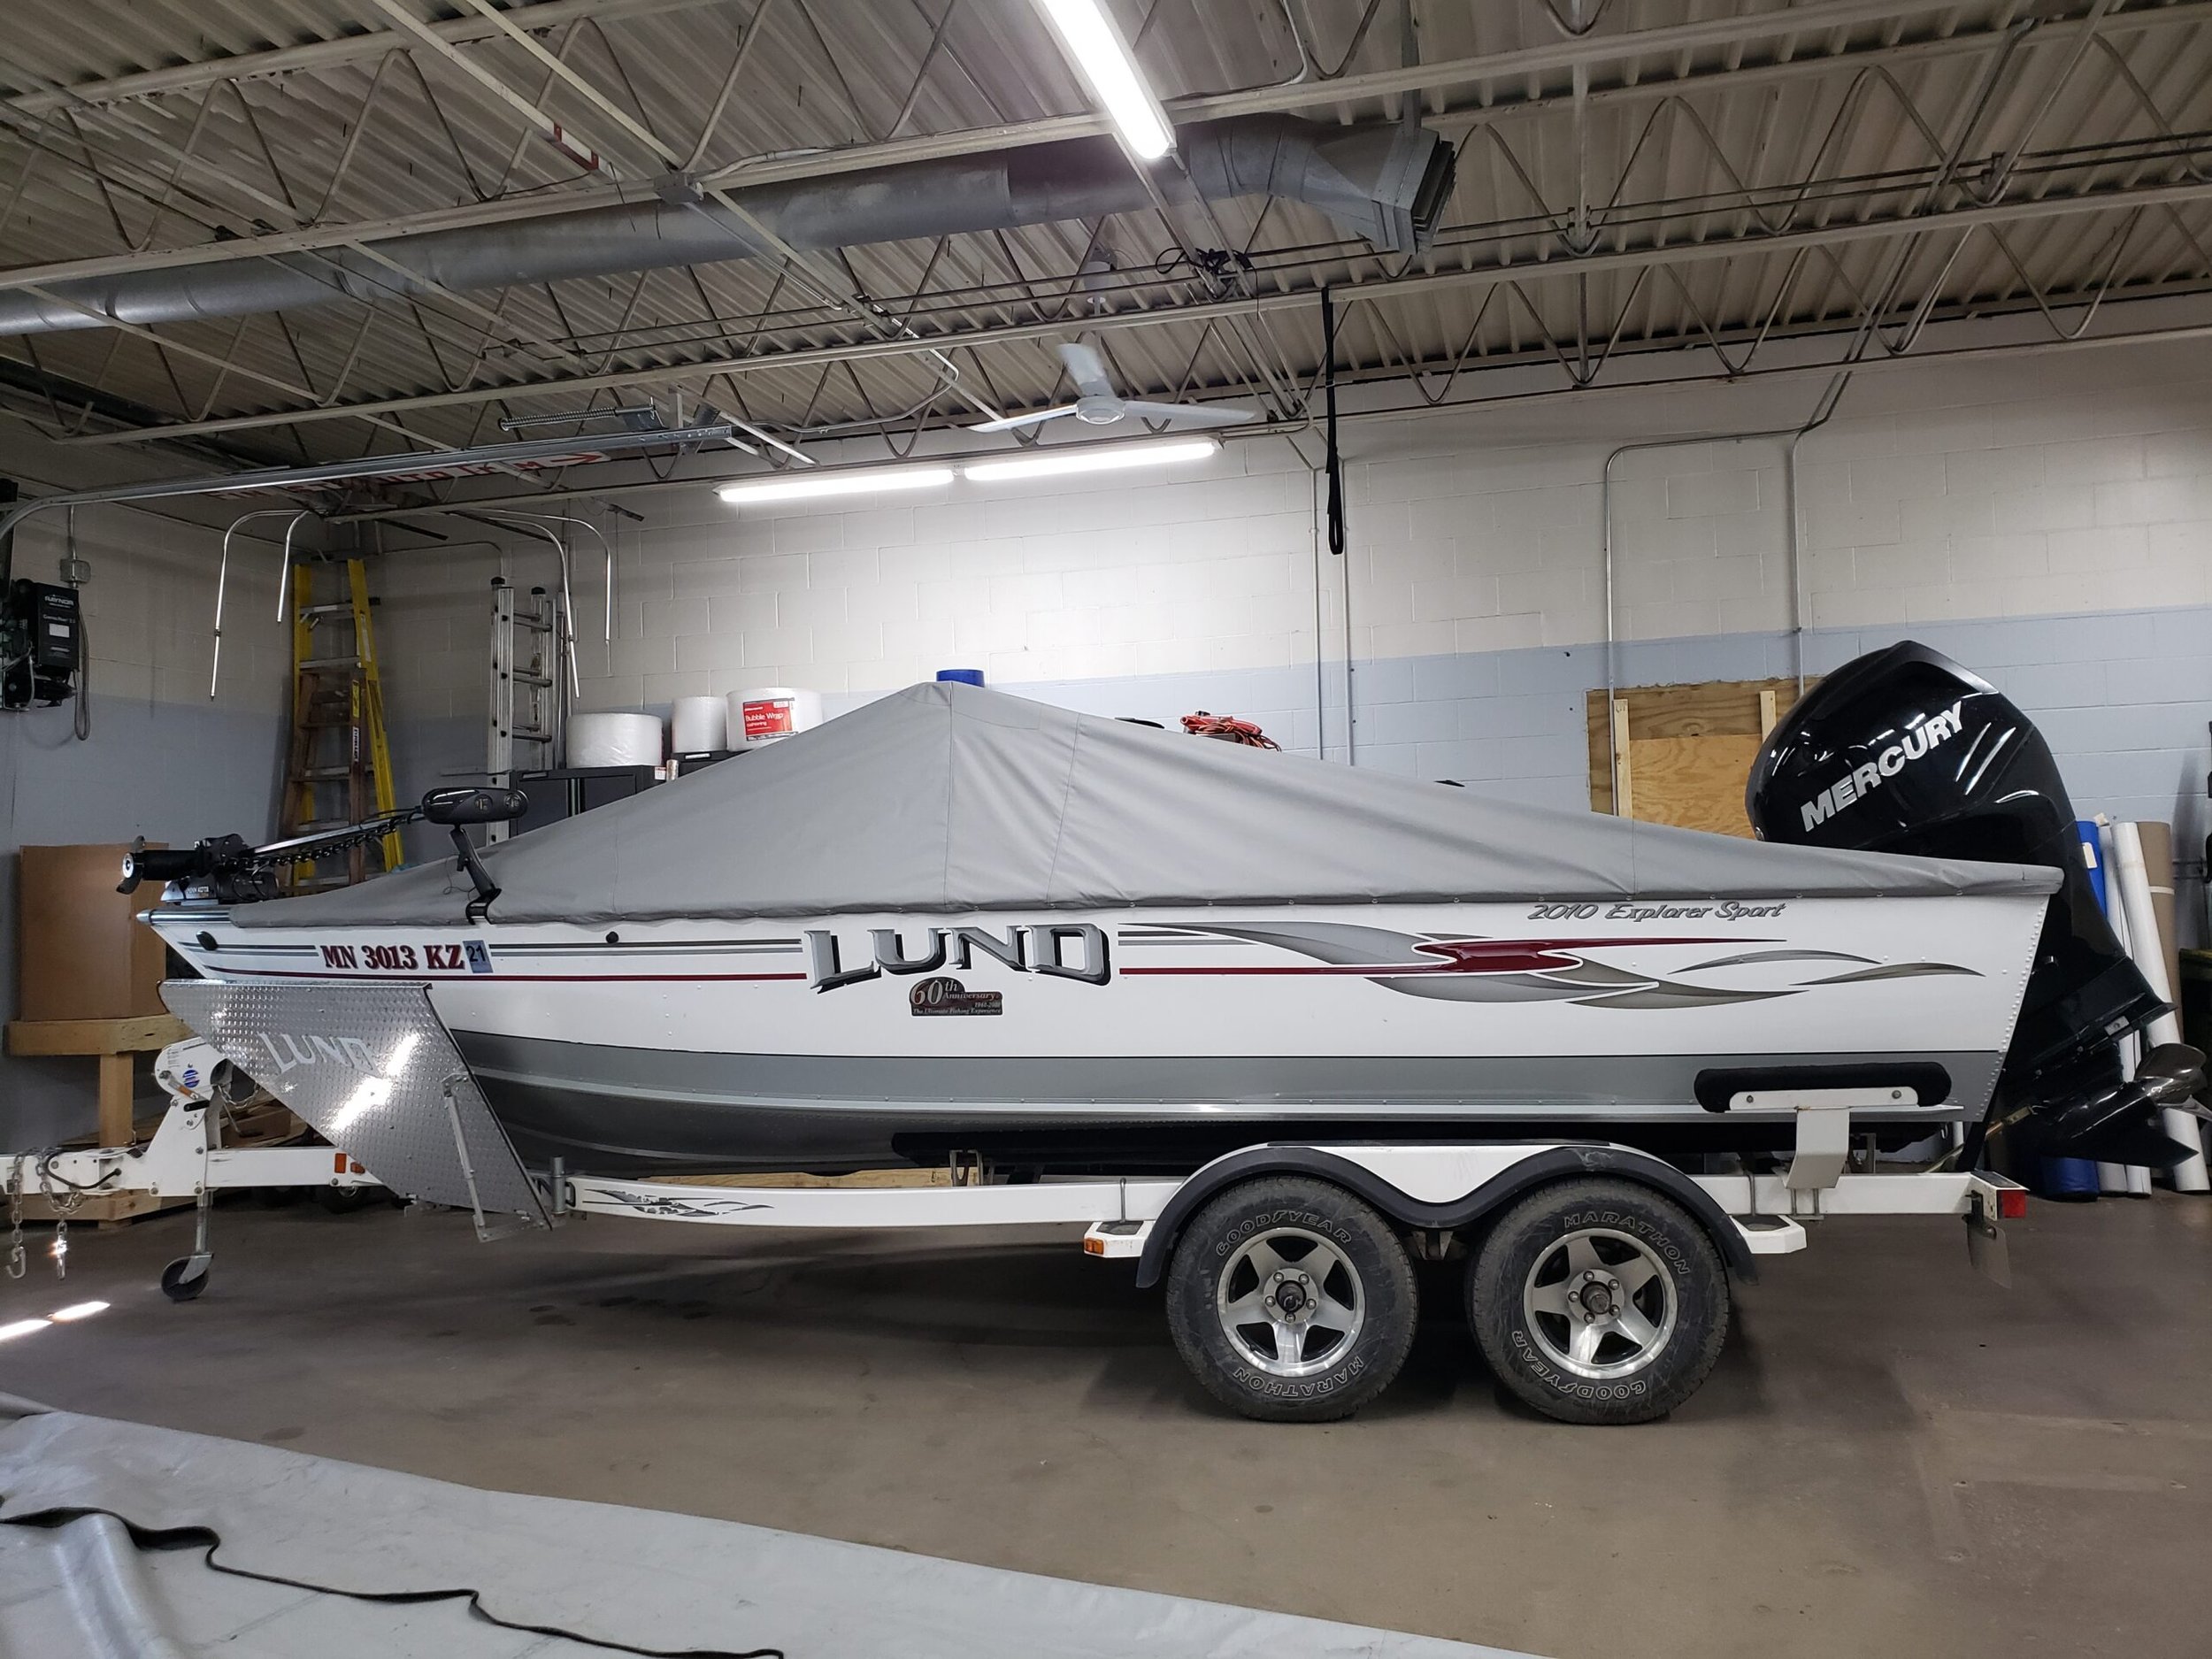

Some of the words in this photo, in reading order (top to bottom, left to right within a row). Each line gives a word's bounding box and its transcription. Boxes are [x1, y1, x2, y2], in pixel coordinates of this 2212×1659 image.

[745, 713, 765, 722] Bubble
[1800, 700, 1962, 833] MERCURY
[1527, 902, 1599, 920] 2010
[1605, 902, 1713, 922] Explorer
[1715, 900, 1786, 922] Sport
[320, 945, 358, 970] MN
[361, 945, 419, 971] 3013
[423, 944, 465, 970] KZ
[465, 945, 486, 963] 21
[803, 923, 1111, 995] LUND
[910, 979, 957, 1004] 60th
[942, 992, 995, 1002] Anniversary
[257, 1032, 387, 1077] LUND
[1216, 1210, 1352, 1256] GOODYEAR
[1563, 1211, 1691, 1274] MARATHON
[1232, 1356, 1364, 1397] MARATHON
[1511, 1330, 1647, 1401] GOODYEAR
